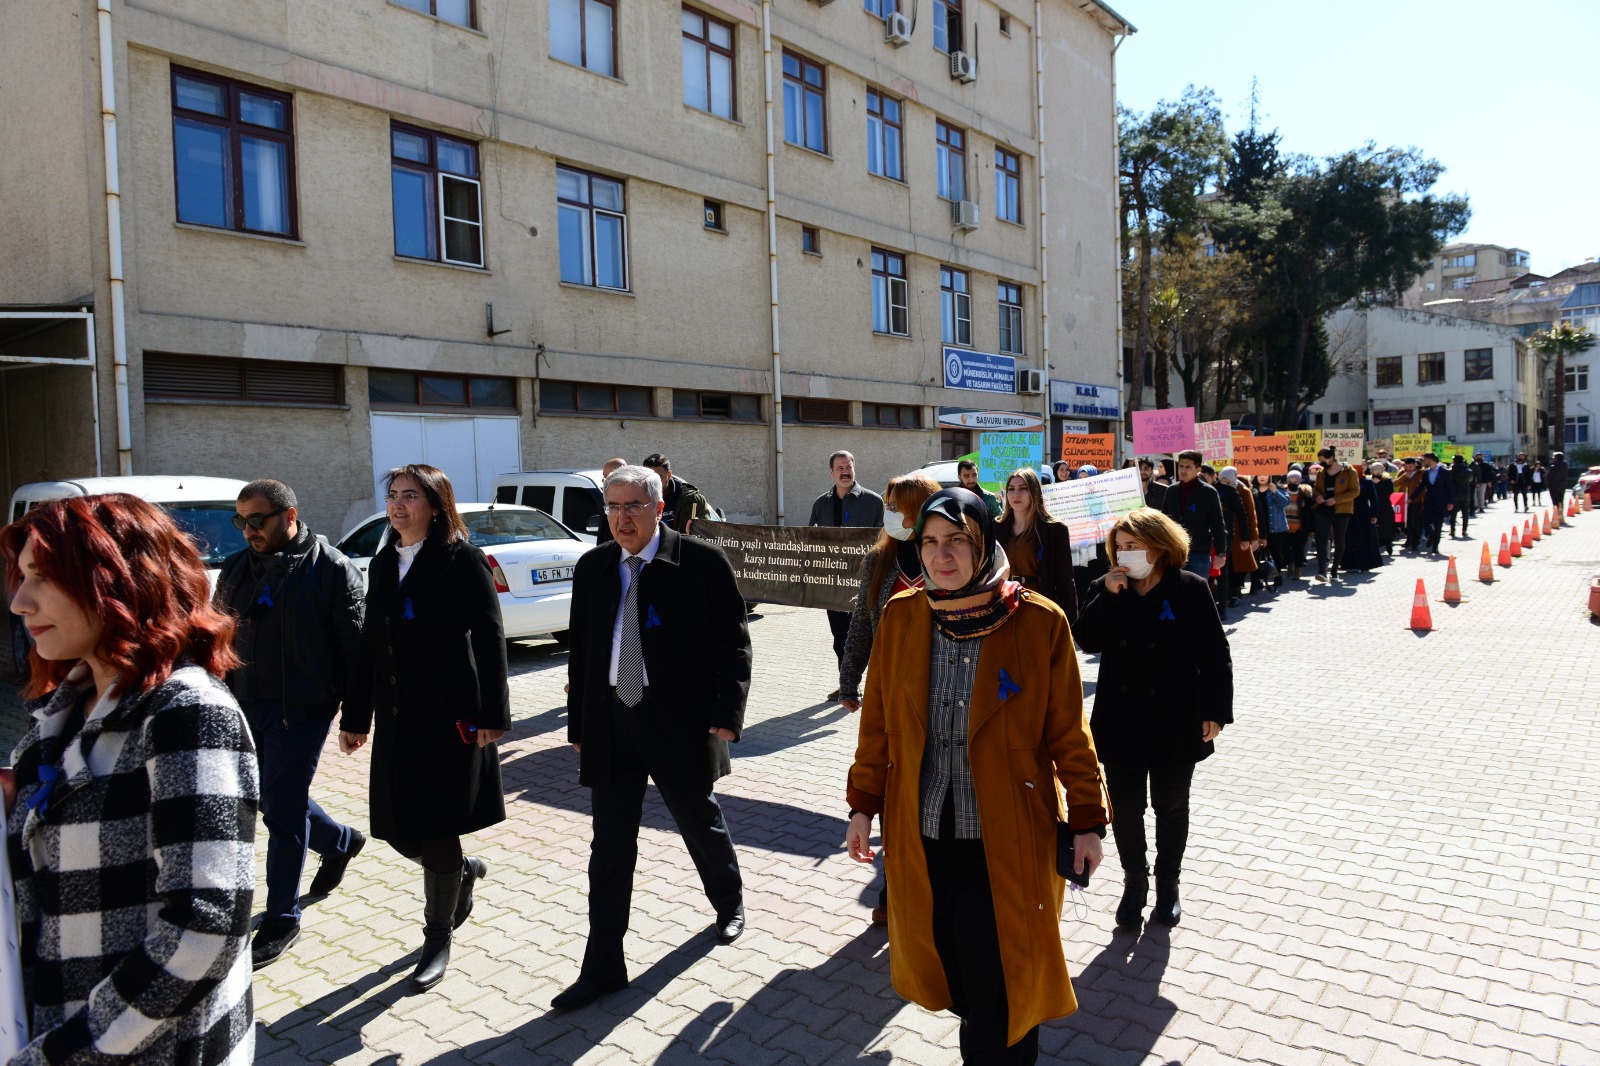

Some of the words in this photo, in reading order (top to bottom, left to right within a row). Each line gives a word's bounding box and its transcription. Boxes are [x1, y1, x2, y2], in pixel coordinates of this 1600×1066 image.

[963, 367, 994, 380] MÜHENDİSLİK,
[993, 371, 1014, 381] MİMARLIK
[966, 379, 972, 387] VE
[972, 380, 991, 389] TASARIM
[991, 381, 1013, 392] FAKÜLTESİ
[1054, 402, 1069, 413] TIP
[976, 416, 1002, 426] BAŞVURU
[1002, 417, 1026, 426] MERKEZİ
[1065, 436, 1105, 446] OTURMAK
[1066, 459, 1112, 468] İGARASIDIR
[740, 538, 761, 551] yaşlı
[764, 540, 826, 553] vatandaşlarına
[828, 545, 840, 554] ve
[841, 544, 871, 555] emekl
[744, 552, 766, 566] karşı
[768, 556, 802, 568] tutumu;
[804, 559, 811, 567] o
[812, 557, 848, 570] milletin
[538, 570, 548, 580] 46
[551, 569, 561, 579] FN
[565, 567, 575, 578] 71
[743, 568, 788, 582] kudretinin
[789, 574, 801, 583] en
[803, 574, 835, 586] önemli
[836, 574, 861, 588] kıstas
